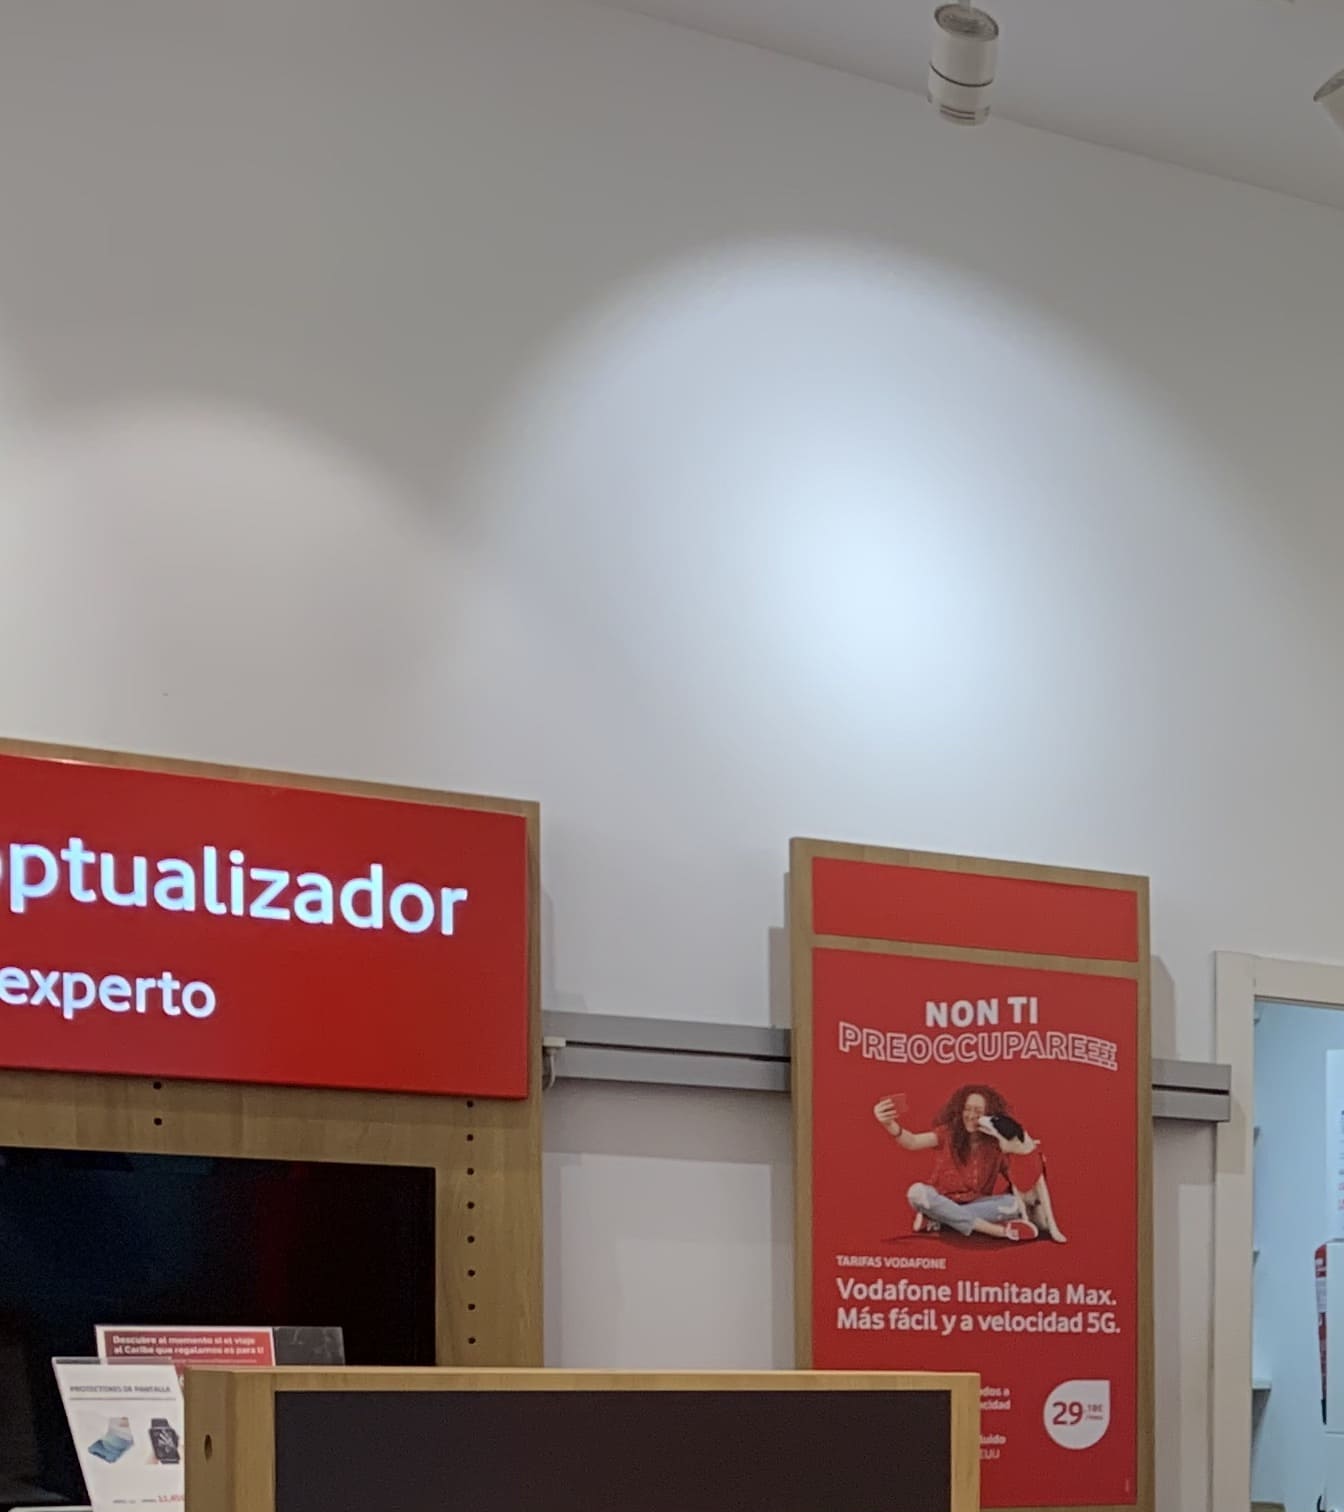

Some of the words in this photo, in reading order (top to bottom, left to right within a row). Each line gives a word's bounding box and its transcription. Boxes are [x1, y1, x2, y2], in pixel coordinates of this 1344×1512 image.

[0, 837, 467, 935] ptualizador
[0, 966, 216, 1020] experto
[926, 999, 998, 1028] NON
[1007, 997, 1037, 1024] TI
[836, 1255, 882, 1268] TARIFAS
[884, 1257, 947, 1270] VODAFONE
[836, 1277, 952, 1302] Vodafone
[957, 1280, 1060, 1304] Ilimitada
[1066, 1283, 1117, 1305] Max.
[837, 1306, 885, 1330] Más
[888, 1307, 938, 1331] fácil
[941, 1314, 957, 1336] y
[960, 1314, 974, 1331] a
[977, 1311, 1083, 1333] velocidad
[1086, 1312, 1121, 1334] 5G.
[1052, 1402, 1083, 1425] 29
